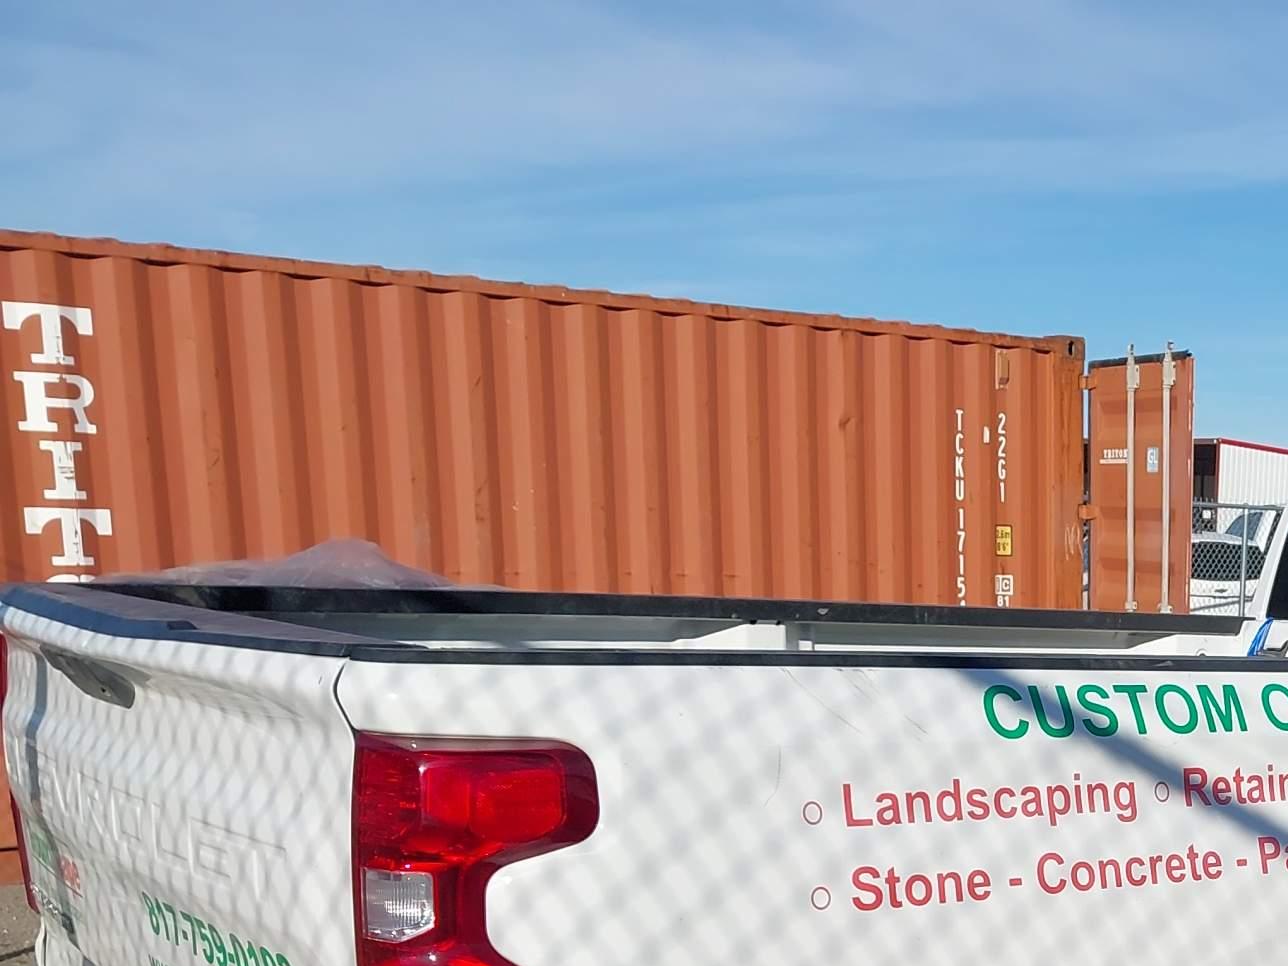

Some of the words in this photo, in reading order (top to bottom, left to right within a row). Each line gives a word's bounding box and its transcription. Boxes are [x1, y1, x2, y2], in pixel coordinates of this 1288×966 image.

[2, 300, 113, 583] TRIT
[955, 409, 965, 501] TCKU
[998, 412, 1007, 503] 22G1
[957, 508, 966, 607] 1715
[983, 684, 1249, 740] CUSTOM
[842, 773, 1138, 828] Landscaping
[851, 866, 993, 912] Stone
[1037, 844, 1223, 895] Concrete
